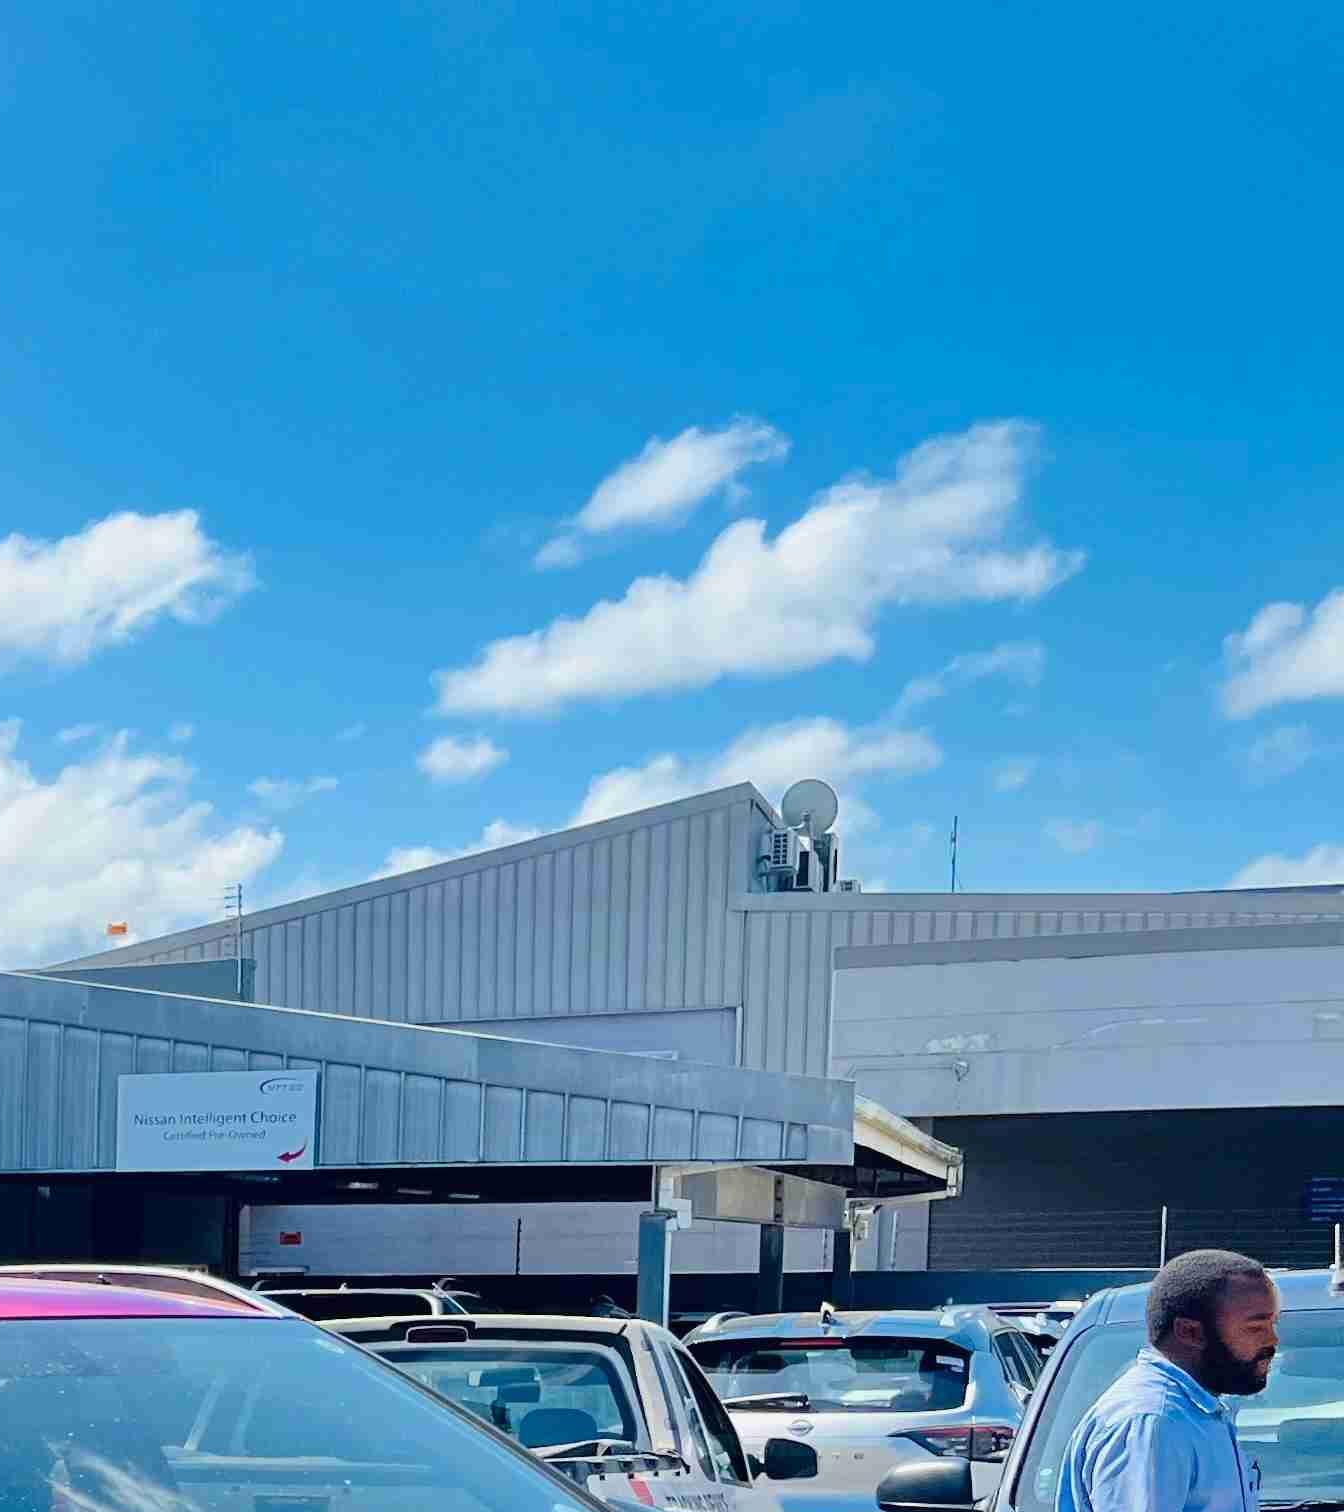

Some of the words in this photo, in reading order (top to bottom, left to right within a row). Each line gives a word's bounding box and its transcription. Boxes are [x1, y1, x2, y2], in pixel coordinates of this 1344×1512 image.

[133, 1112, 176, 1126] Nissan
[179, 1111, 247, 1128] Intelligent
[250, 1110, 297, 1125] Choice
